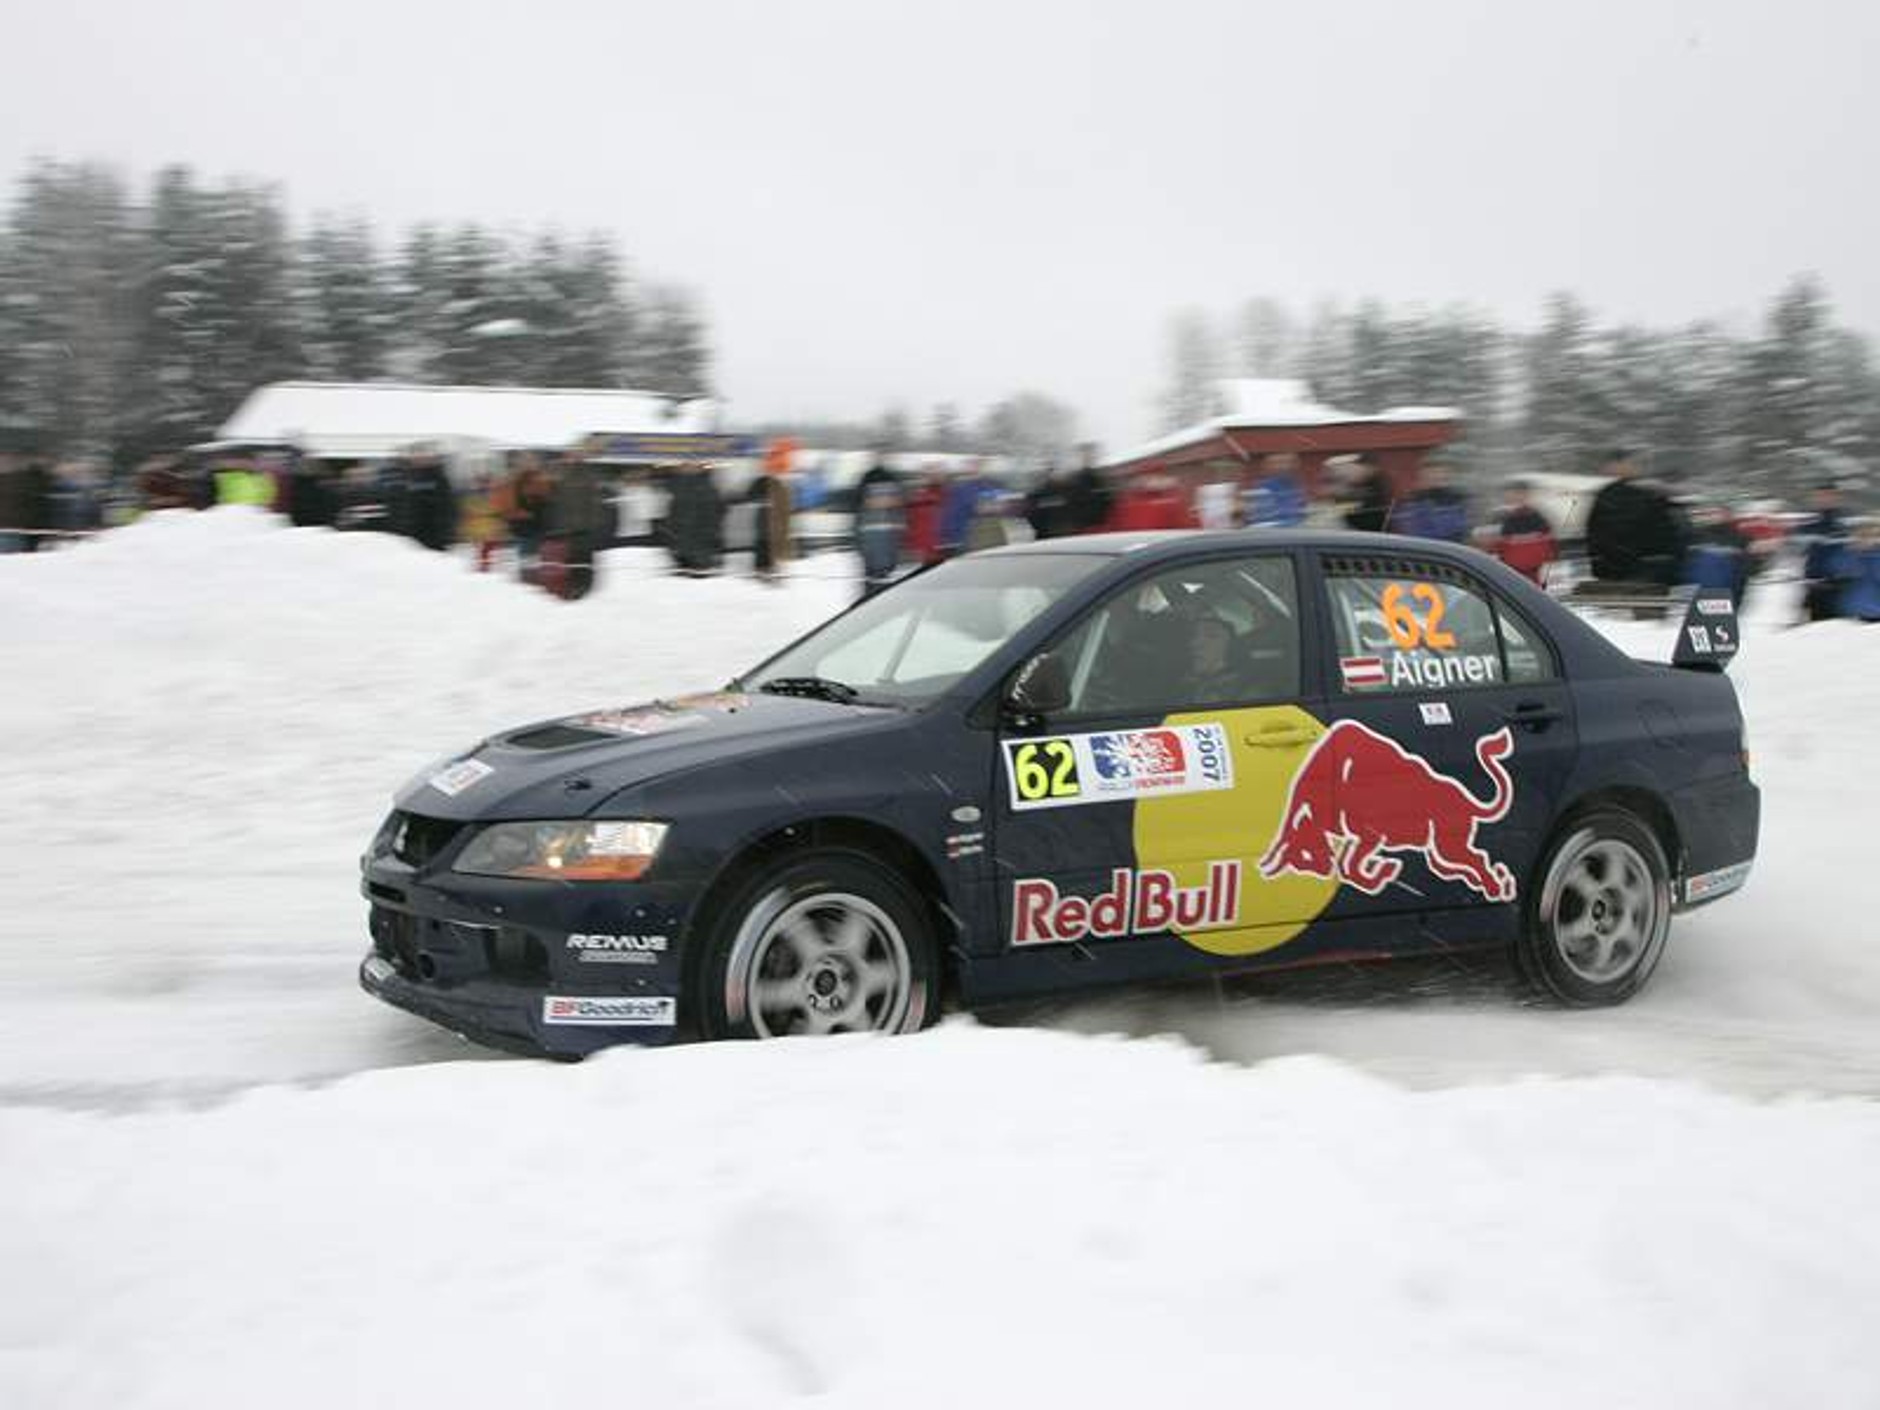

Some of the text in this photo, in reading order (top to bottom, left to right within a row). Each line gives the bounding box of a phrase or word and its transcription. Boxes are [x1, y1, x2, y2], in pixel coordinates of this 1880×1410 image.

[1382, 581, 1457, 650] 62
[1391, 651, 1496, 688] Aigner
[1014, 740, 1079, 799] 62
[1193, 728, 1221, 782] 2007
[1013, 861, 1242, 945] Red Bull
[566, 932, 669, 951] REMUS
